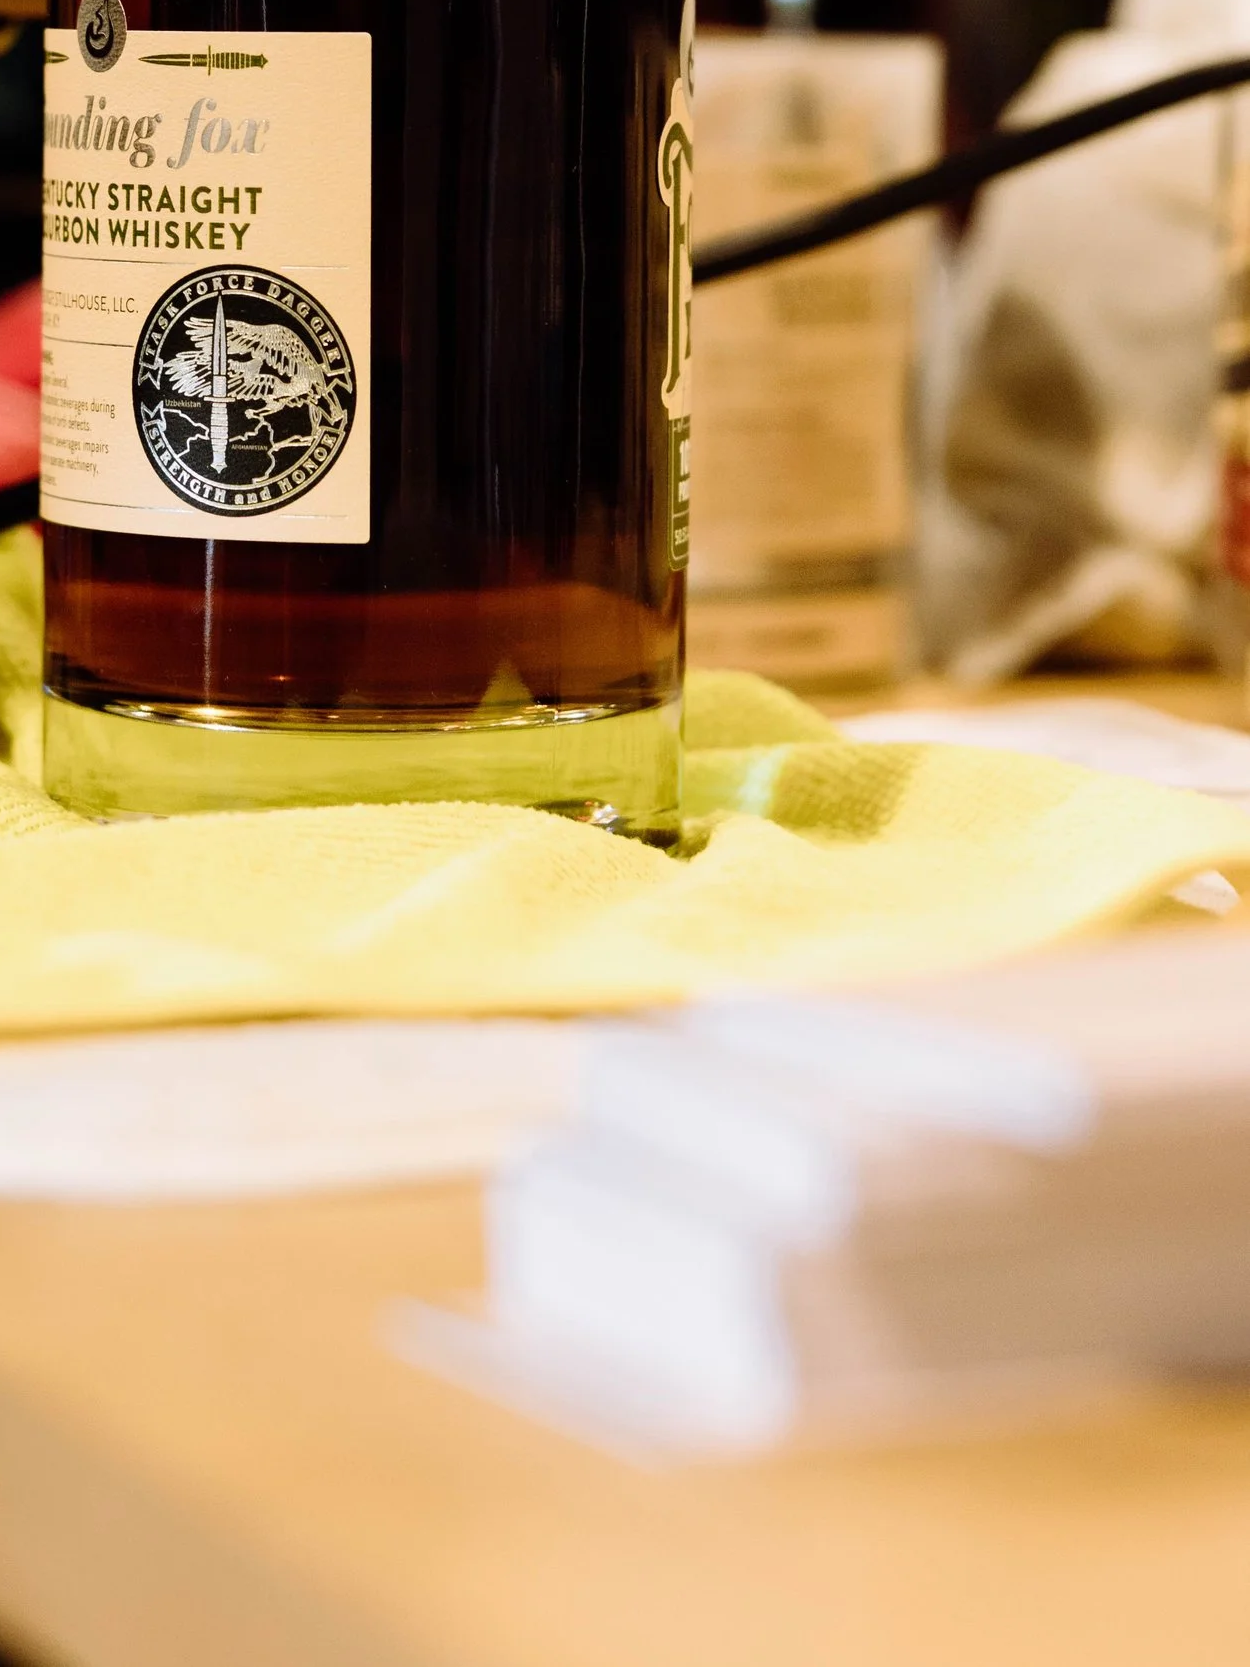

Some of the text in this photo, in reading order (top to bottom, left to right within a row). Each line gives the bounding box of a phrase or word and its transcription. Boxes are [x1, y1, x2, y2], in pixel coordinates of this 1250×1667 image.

[166, 97, 271, 170] fox
[107, 183, 263, 215] STRAIGHT
[108, 219, 251, 251] WHISKEY
[113, 296, 139, 314] LLC.
[145, 275, 342, 364] TASK FORCE DAGGER
[90, 398, 116, 419] during
[164, 399, 202, 408] Uzbekistan
[83, 439, 109, 456] impairs
[149, 427, 338, 505] STRENGTH and HONOR
